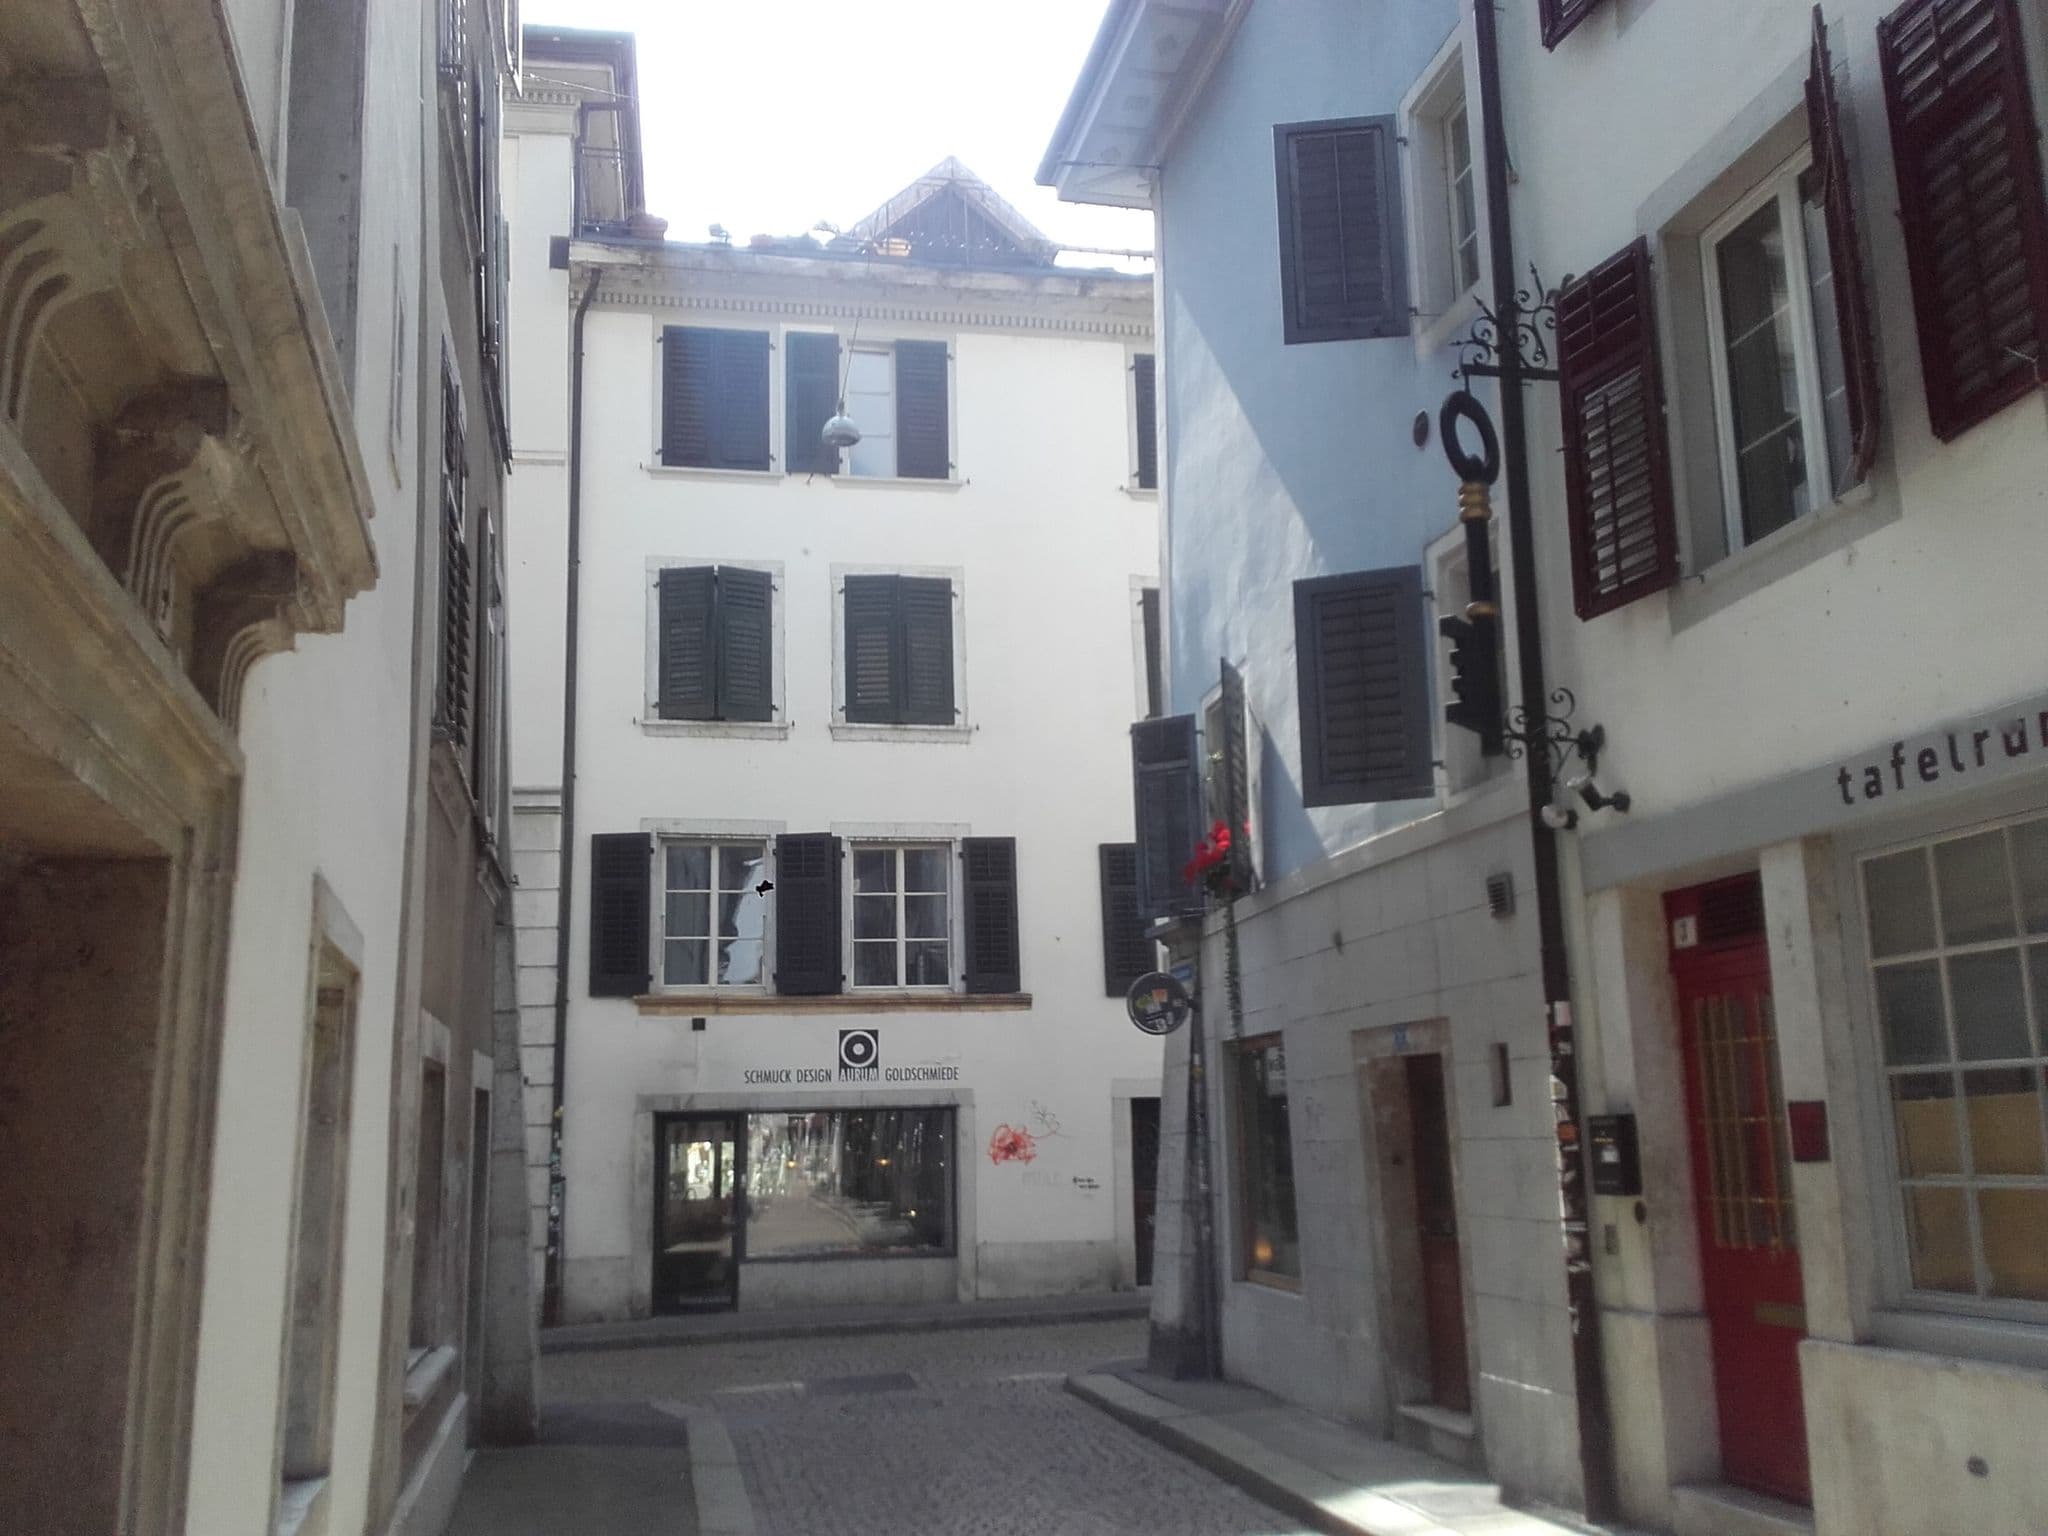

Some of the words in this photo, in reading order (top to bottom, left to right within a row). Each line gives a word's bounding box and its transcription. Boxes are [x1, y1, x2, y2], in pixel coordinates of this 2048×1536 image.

[744, 1068, 792, 1084] SCHMUCK
[796, 1067, 832, 1083] DESIGN
[839, 1067, 879, 1082] AURUM
[885, 1066, 959, 1081] GOLDSCHMIEDE
